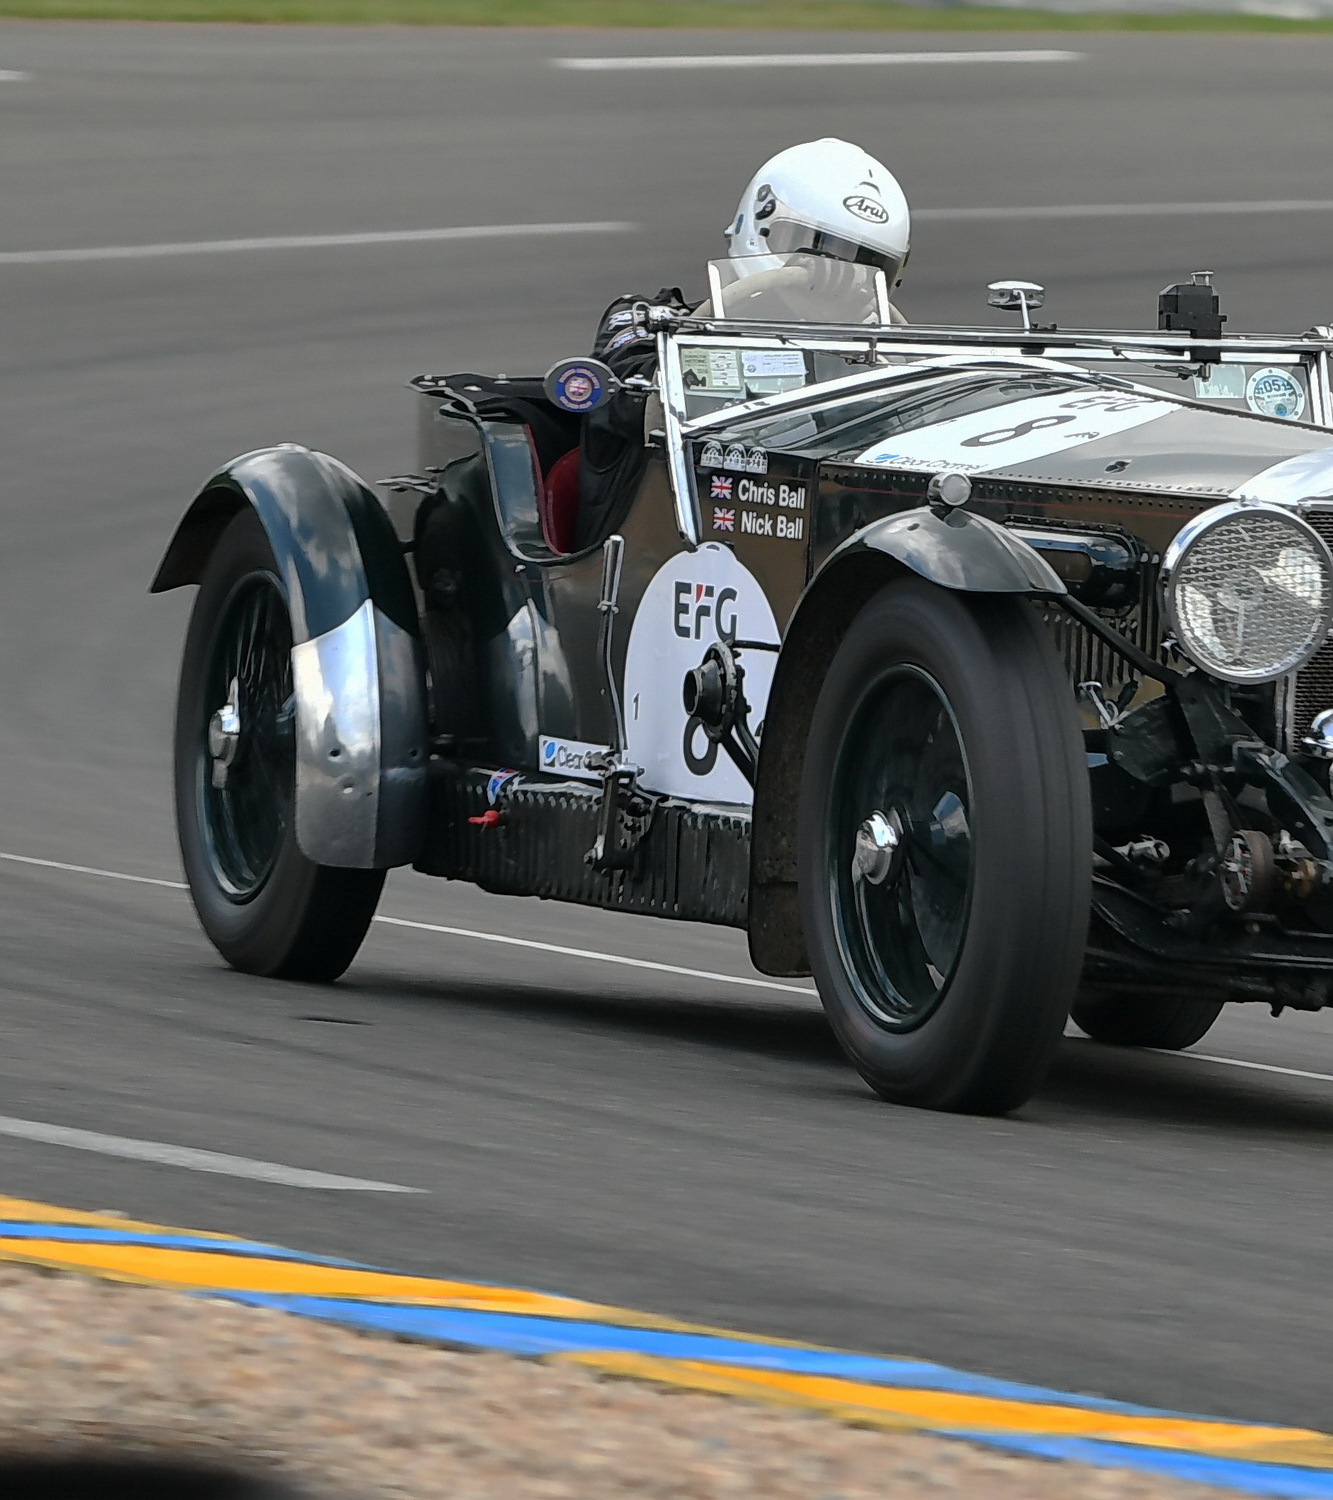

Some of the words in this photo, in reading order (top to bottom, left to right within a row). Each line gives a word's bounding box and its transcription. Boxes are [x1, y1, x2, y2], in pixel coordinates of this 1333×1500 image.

[846, 198, 884, 219] Arai
[960, 415, 1077, 447] 8
[738, 479, 776, 506] Chris
[778, 484, 806, 510] Ball
[740, 511, 773, 537] Nick
[776, 515, 804, 540] Ball
[674, 581, 737, 642] EFG
[632, 693, 640, 720] 1
